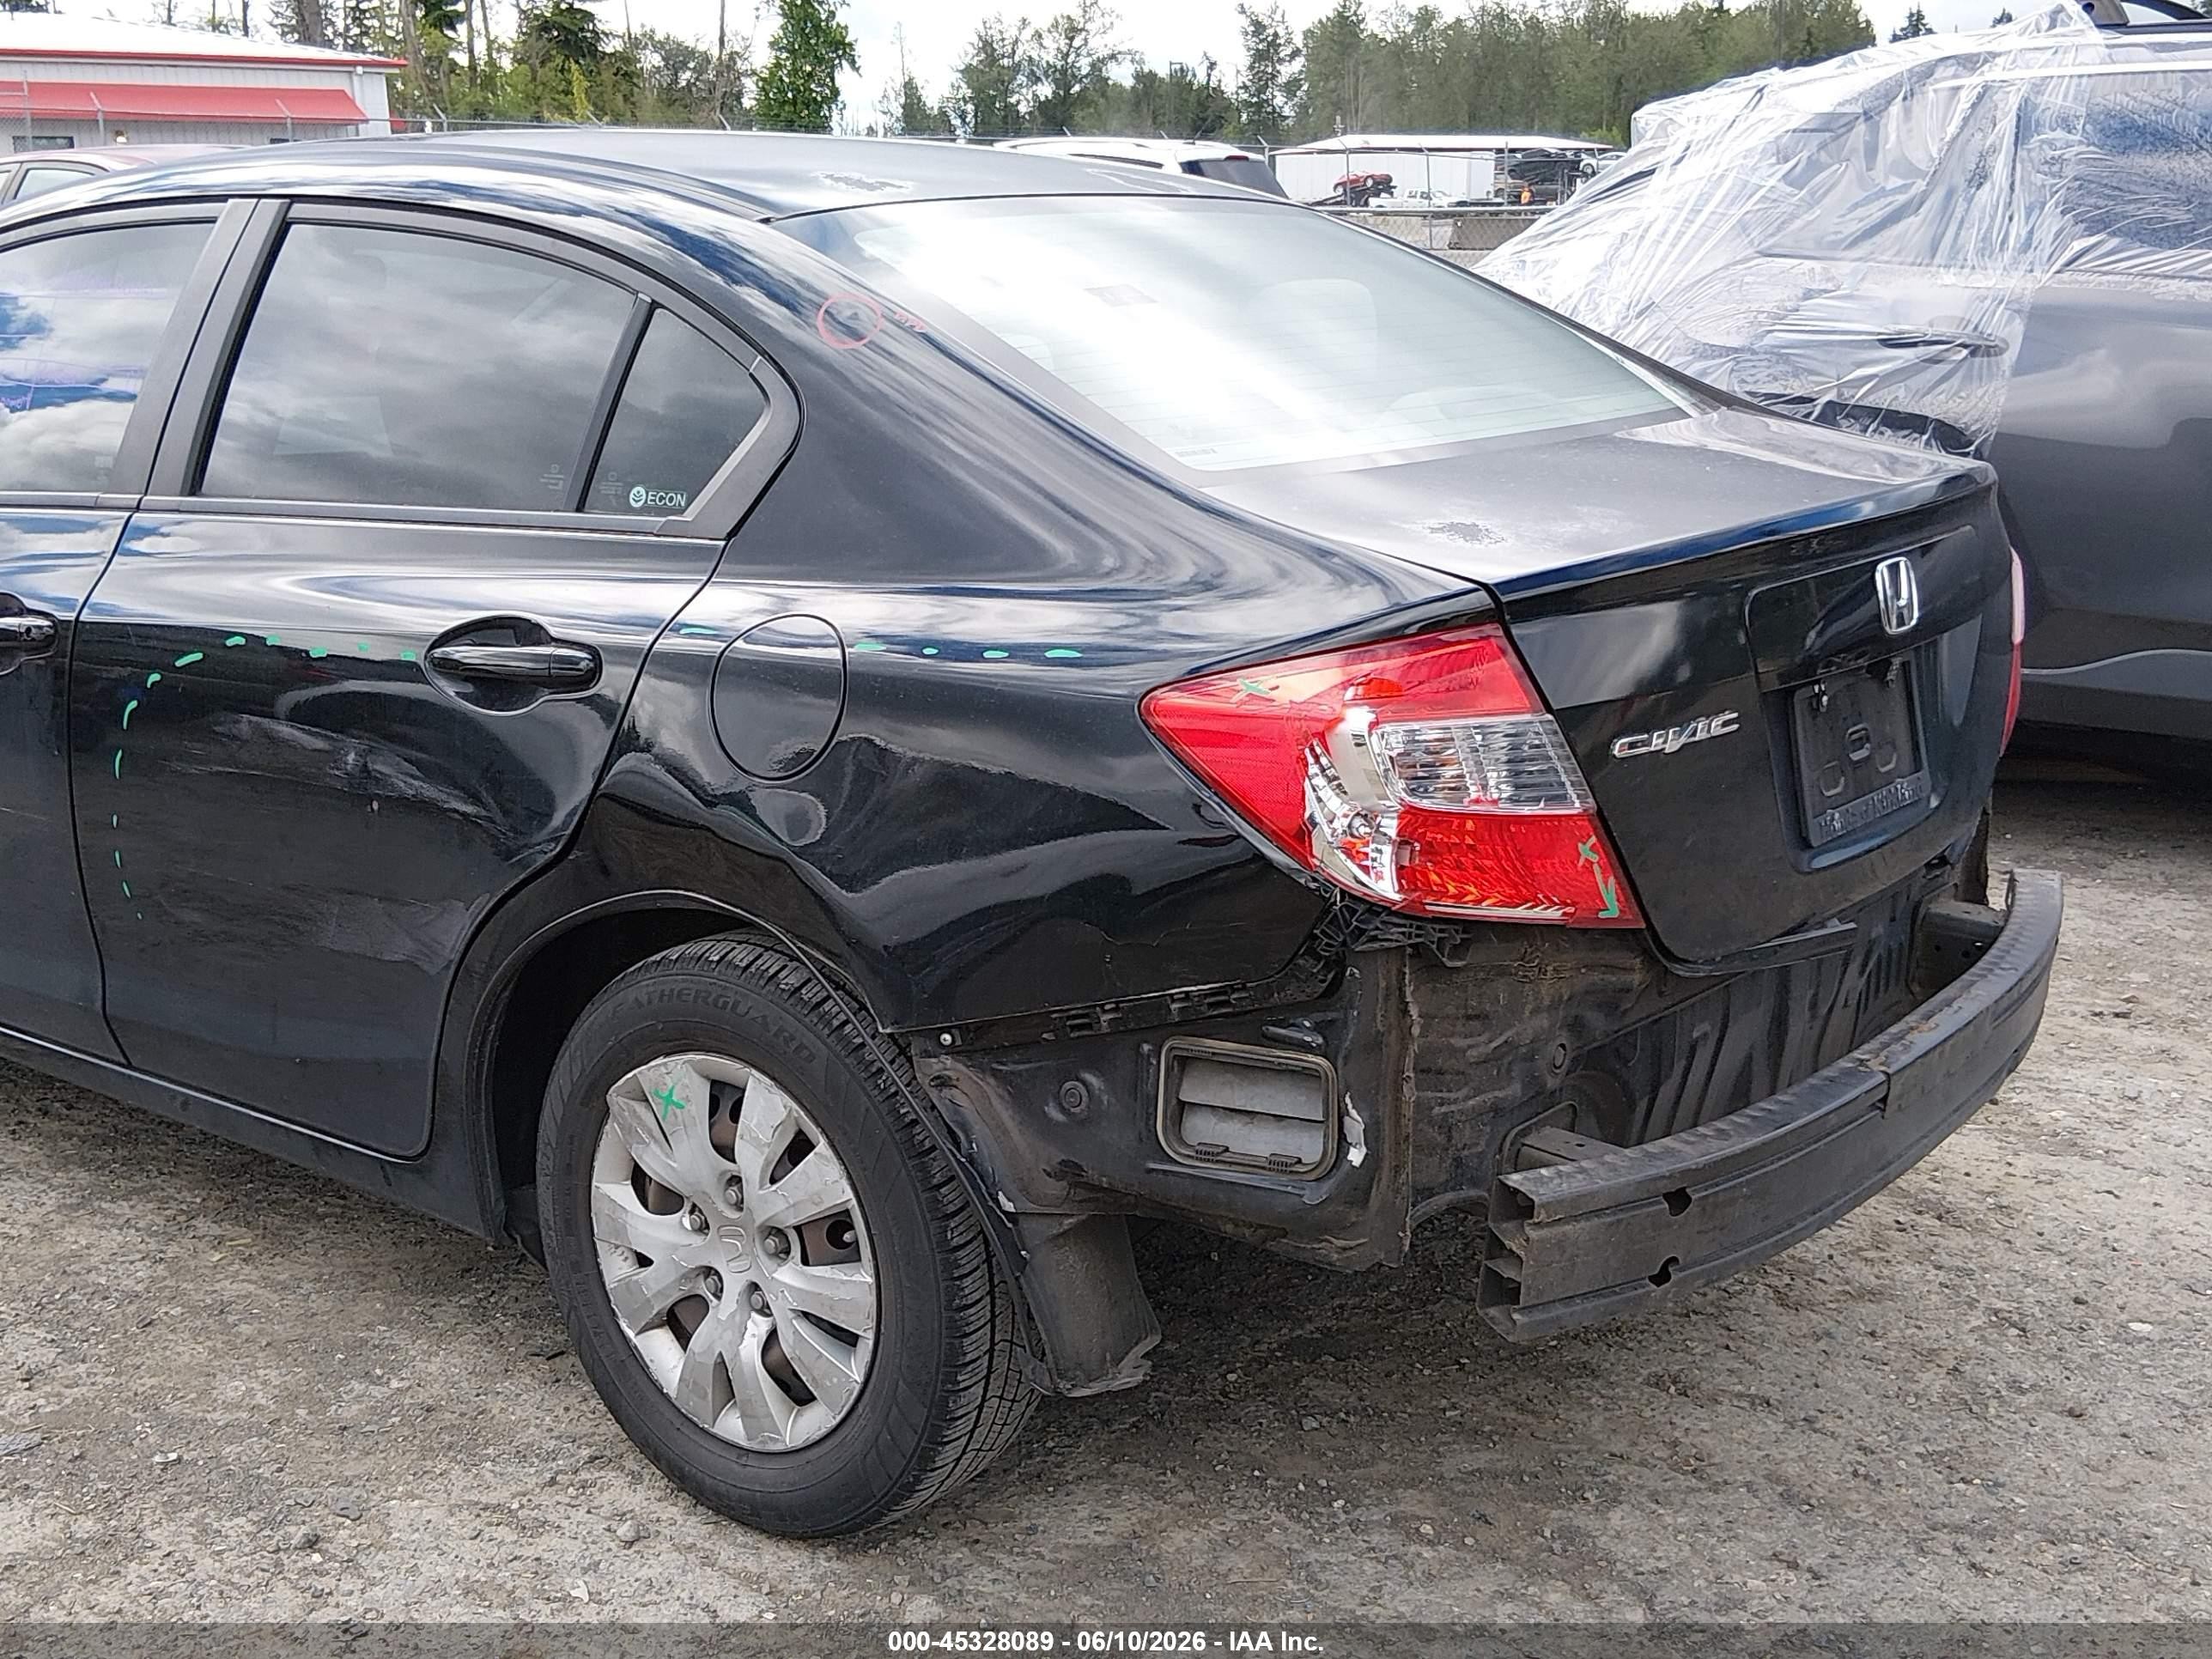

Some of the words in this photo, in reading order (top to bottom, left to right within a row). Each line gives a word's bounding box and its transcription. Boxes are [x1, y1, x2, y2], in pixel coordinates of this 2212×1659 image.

[647, 491, 686, 507] ECON
[1612, 710, 1741, 758] CIVIC
[610, 986, 818, 1066] EATHERGUARD
